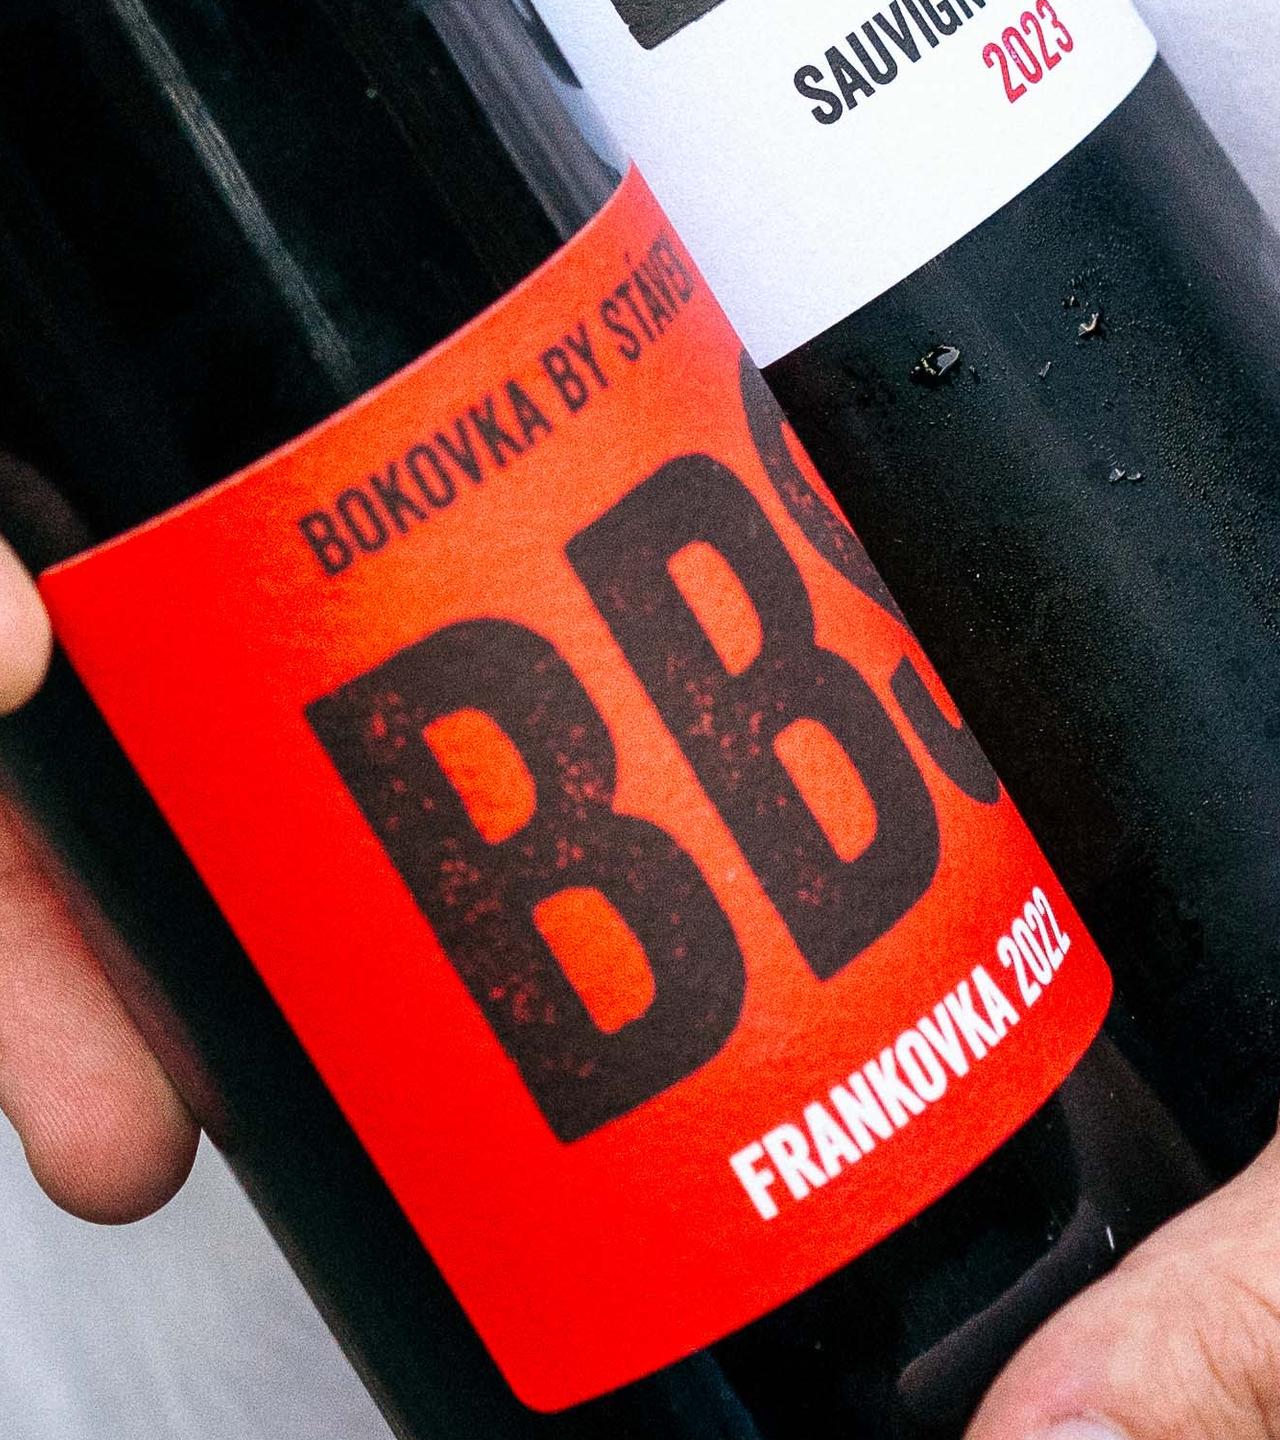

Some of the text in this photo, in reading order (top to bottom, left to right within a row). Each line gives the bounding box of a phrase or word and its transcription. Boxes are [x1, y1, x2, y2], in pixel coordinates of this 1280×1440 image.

[298, 378, 554, 577] BOKOVKA
[540, 320, 610, 414] BY
[729, 885, 1073, 1221] FRANKOVKA 2022
